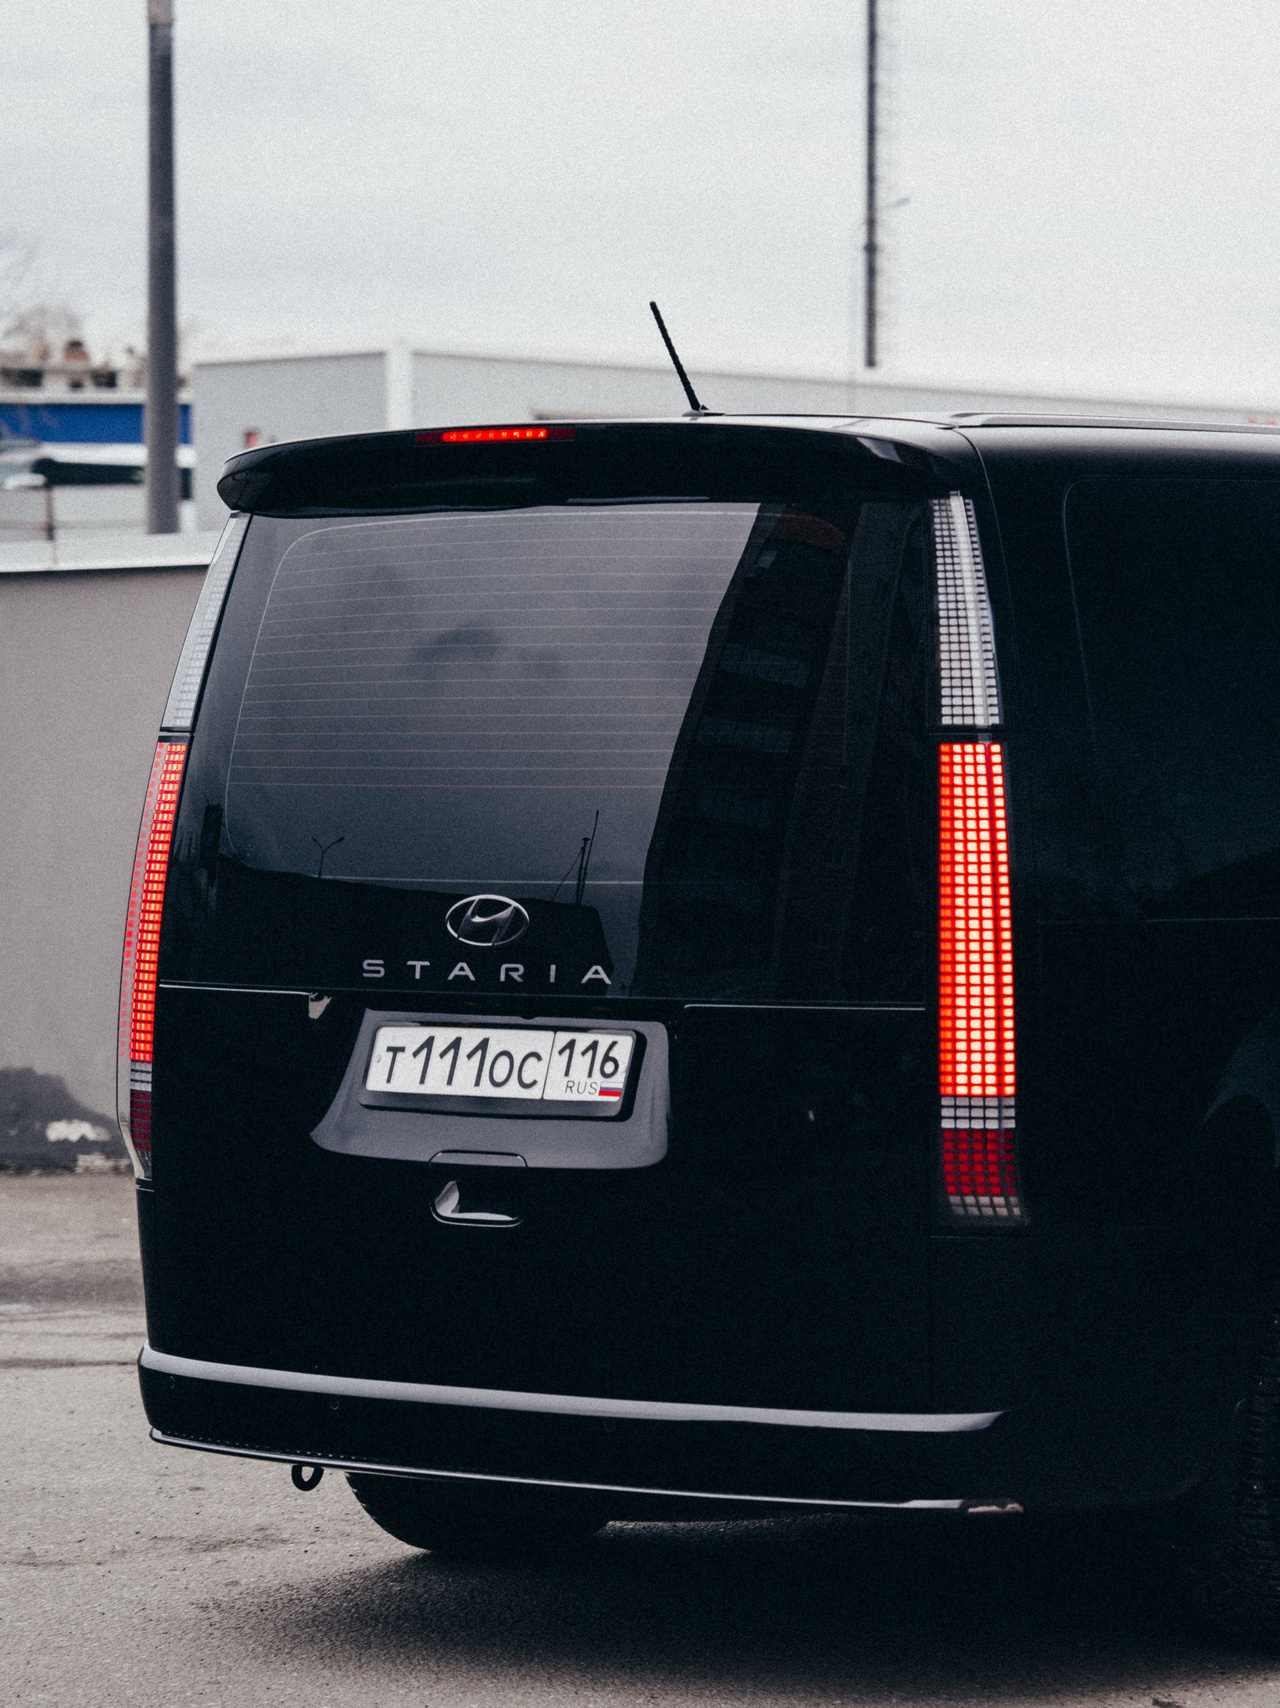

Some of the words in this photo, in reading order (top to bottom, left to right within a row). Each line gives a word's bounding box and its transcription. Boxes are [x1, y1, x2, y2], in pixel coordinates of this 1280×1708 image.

[362, 959, 612, 985] STARIA
[558, 1038, 620, 1079] 116
[564, 1080, 598, 1095] RUS
